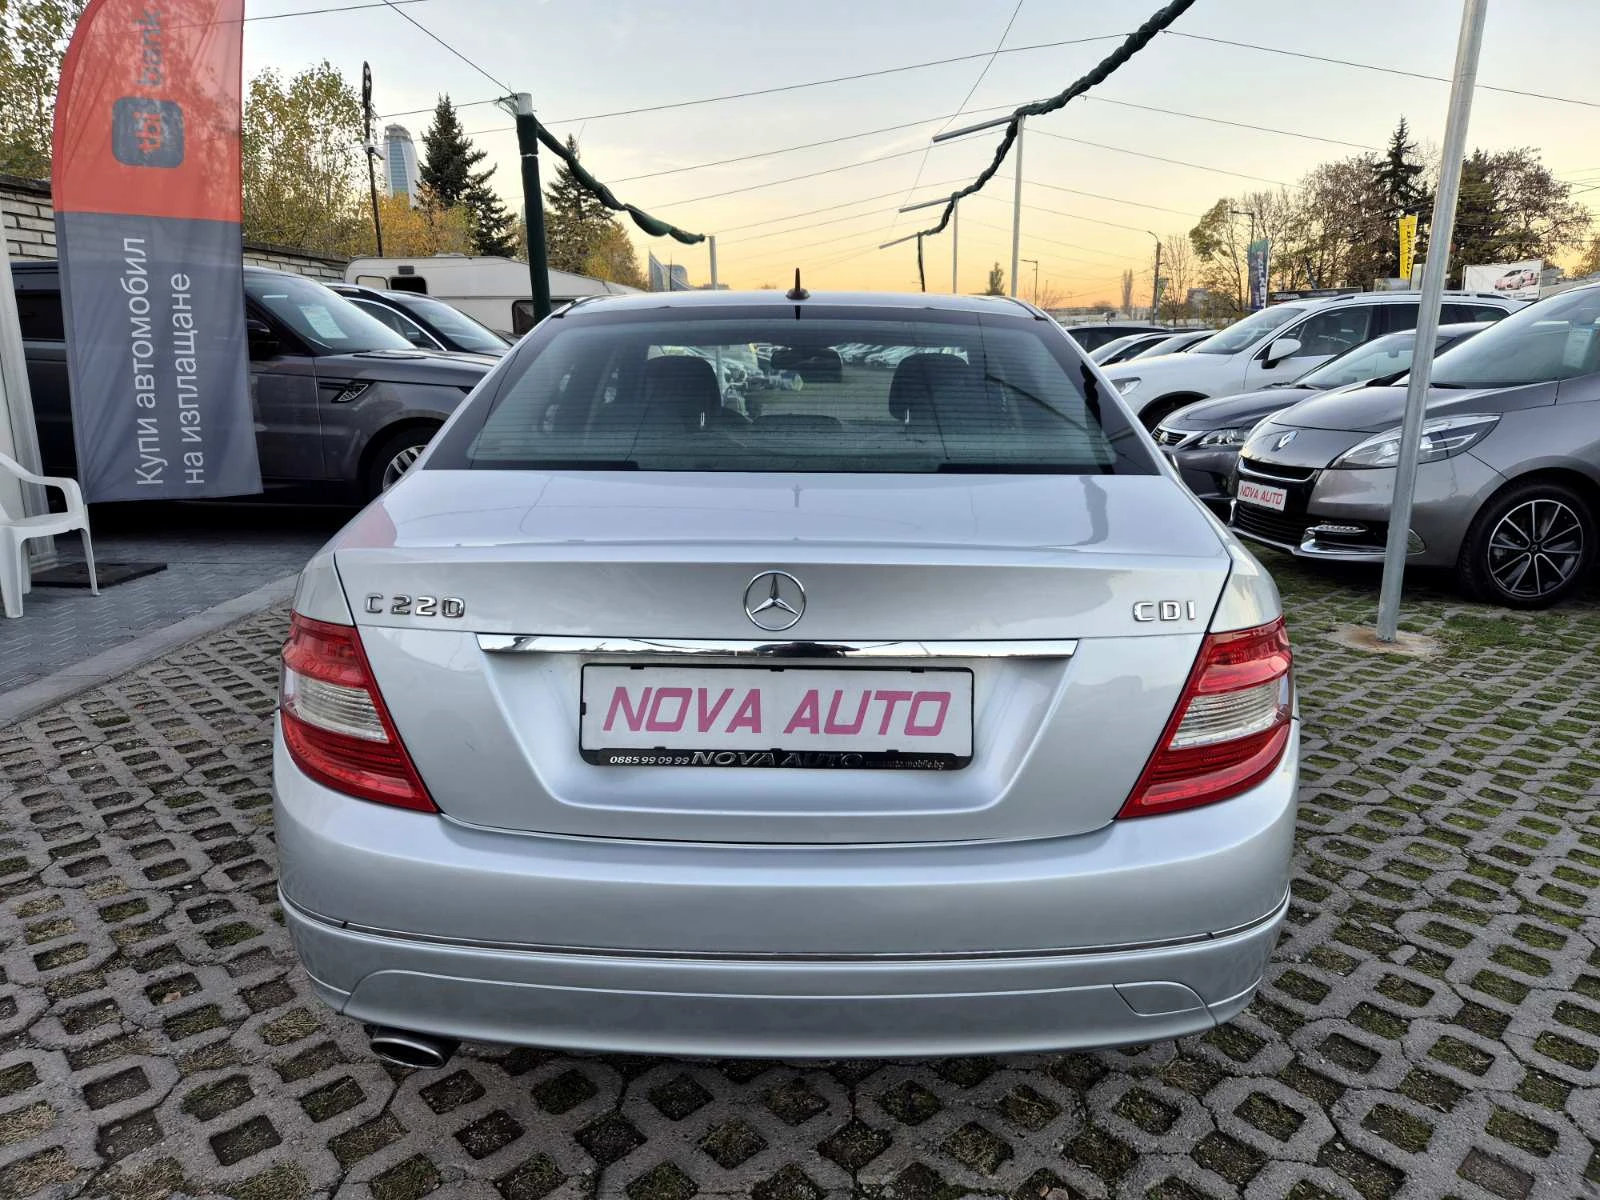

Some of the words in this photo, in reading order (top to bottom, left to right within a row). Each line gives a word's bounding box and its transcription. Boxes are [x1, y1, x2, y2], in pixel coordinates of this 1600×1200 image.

[135, 10, 161, 85] bank
[132, 111, 161, 153] tbi
[120, 237, 156, 408] автомобил
[170, 273, 202, 442] изплащане
[134, 418, 168, 485] Купи
[183, 451, 204, 484] на
[1240, 485, 1259, 499] NOVA
[1260, 490, 1283, 505] AUTO
[366, 592, 384, 614] C
[390, 593, 465, 618] 220
[1132, 600, 1197, 622] CDI
[603, 686, 761, 733] NOVA
[783, 690, 951, 736] AUTO
[609, 755, 639, 764] 0885
[641, 756, 656, 764] 99
[657, 756, 672, 765] 09
[674, 757, 689, 765] 99
[691, 751, 776, 766] NOVA
